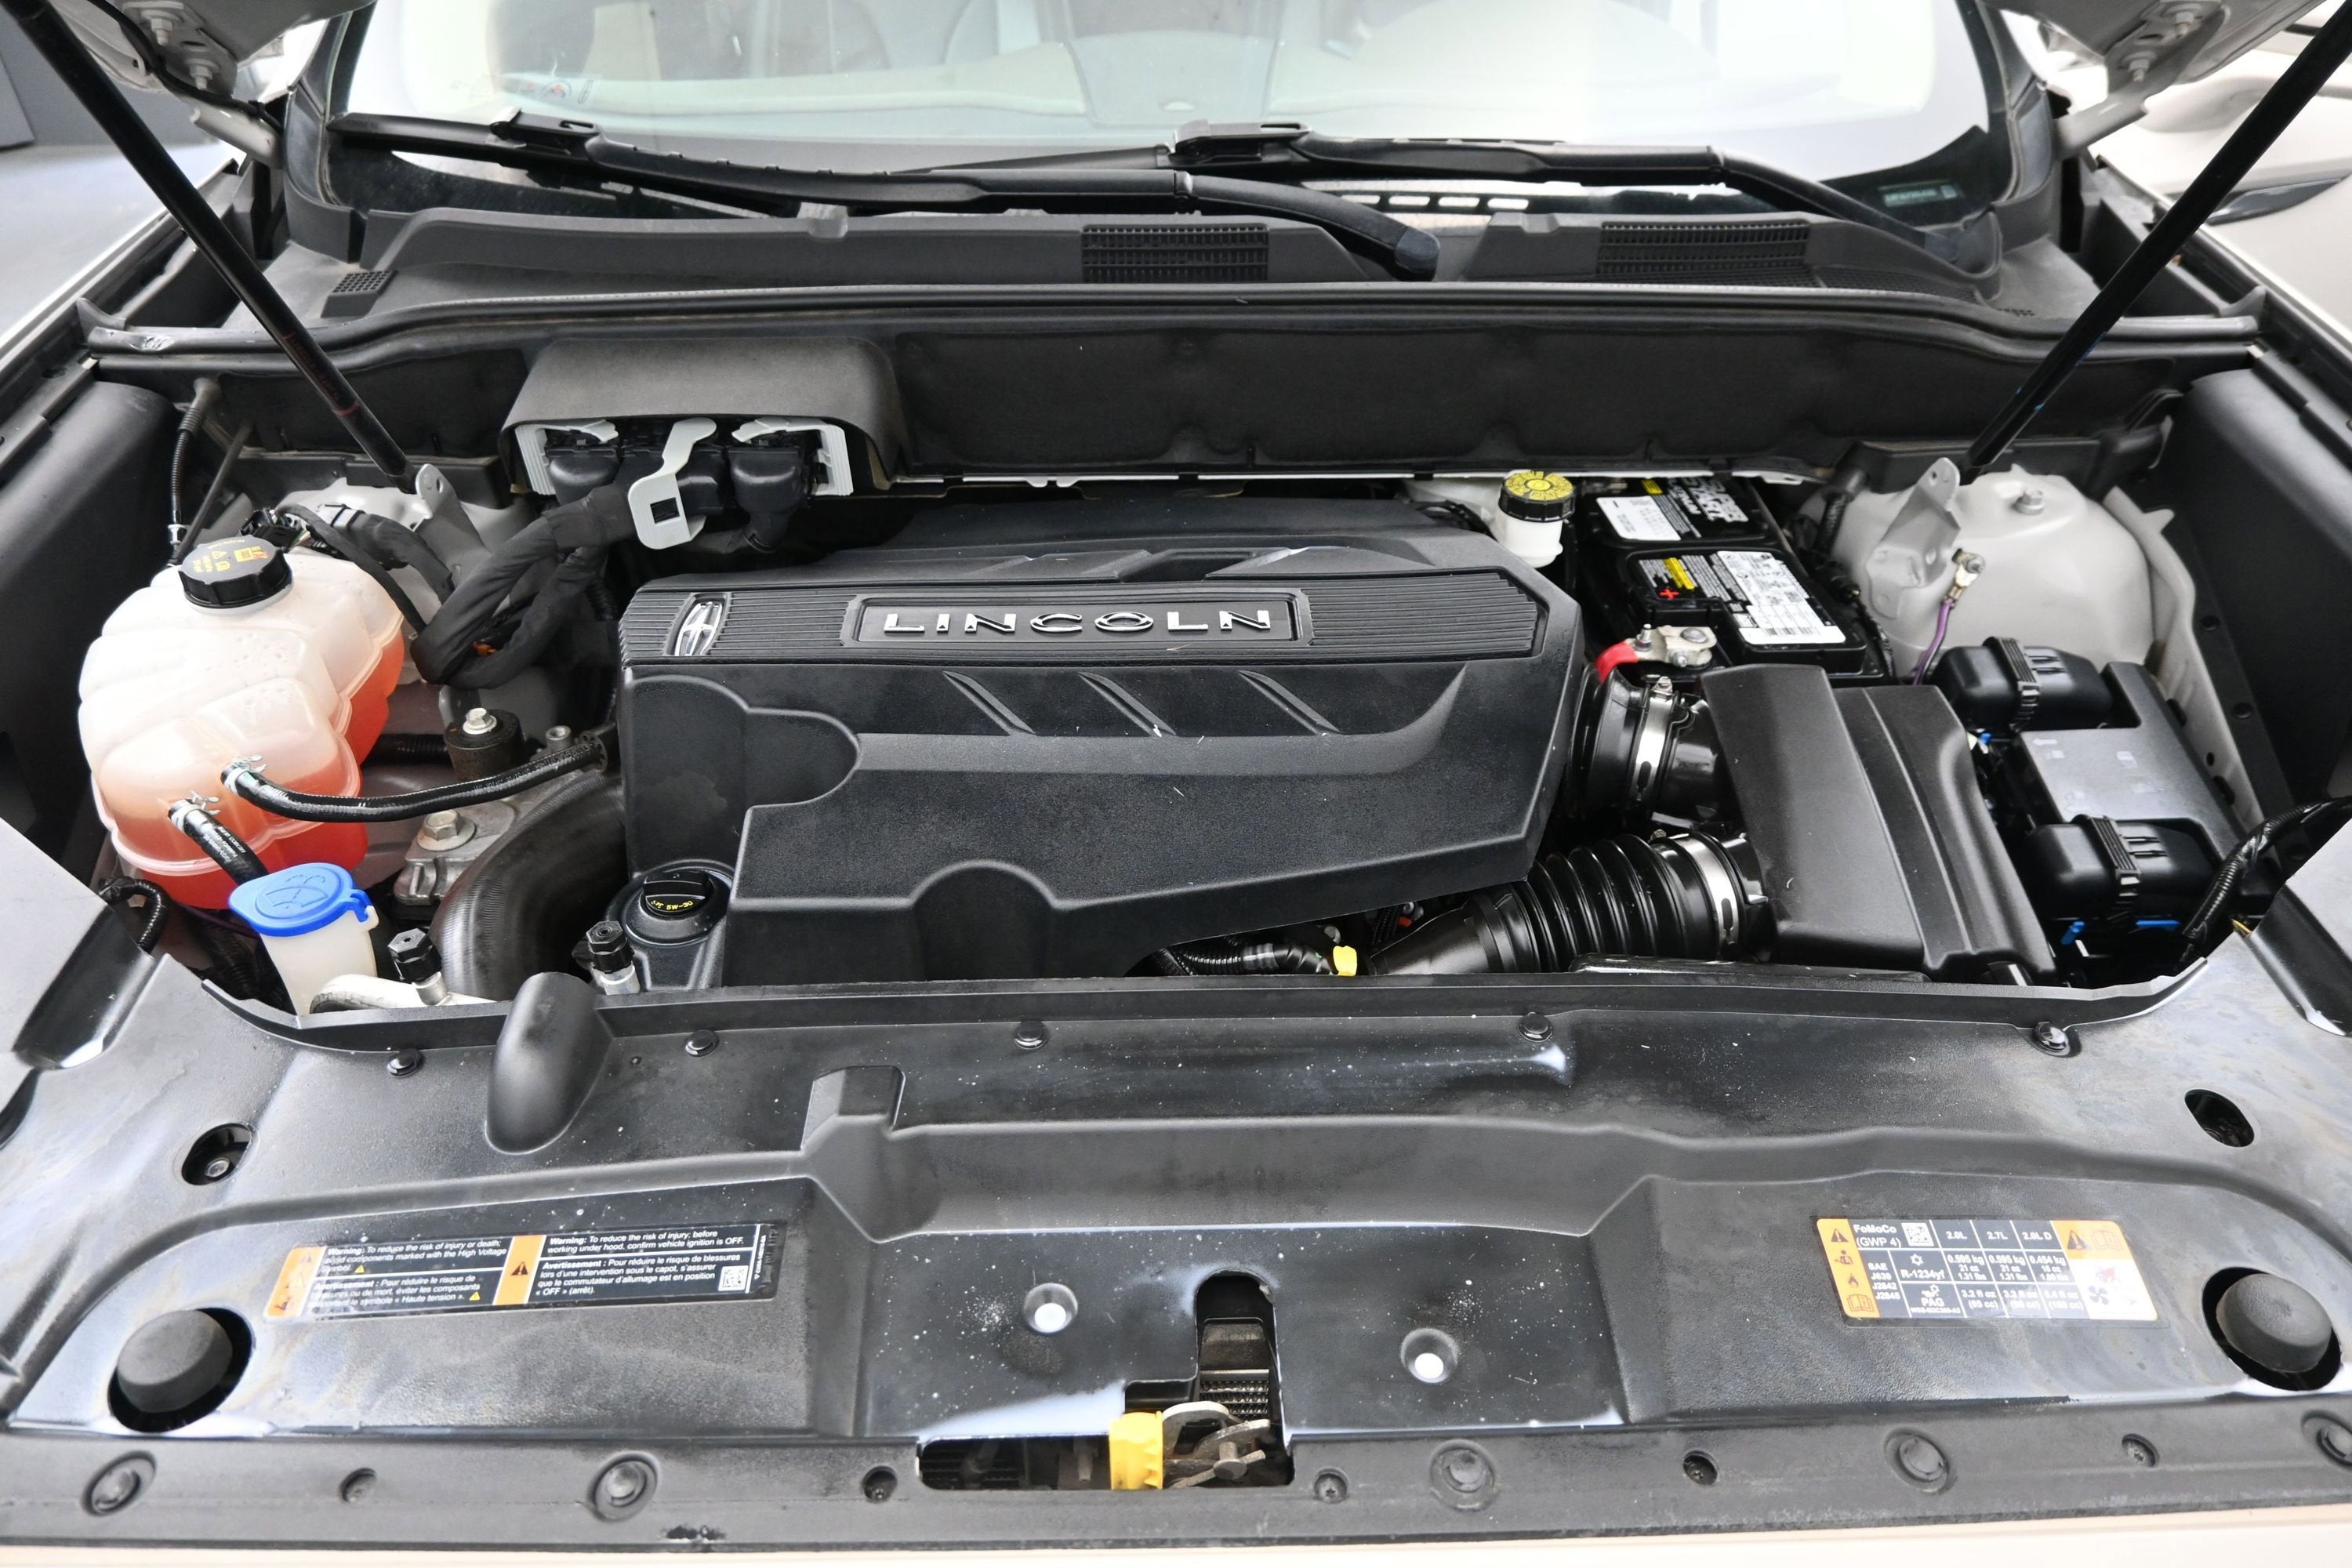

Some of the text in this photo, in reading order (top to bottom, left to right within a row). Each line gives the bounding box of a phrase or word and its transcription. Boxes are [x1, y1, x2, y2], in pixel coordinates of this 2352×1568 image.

[884, 610, 1271, 633] LINCOLN
[666, 900, 694, 910] 5W-30
[1853, 1224, 1897, 1233] FoMoCo
[2022, 1232, 2042, 1240] 2.0L
[687, 1239, 715, 1248] ignition
[725, 1236, 744, 1245] OFF.
[1857, 1238, 1901, 1248] (GWP 4)
[377, 1245, 405, 1254] reduce
[444, 1241, 466, 1250] injury
[347, 1254, 394, 1264] components
[395, 1252, 426, 1261] marked
[457, 1248, 476, 1258] High
[477, 1248, 507, 1257] Voltage
[1972, 1255, 1985, 1265] kg
[2013, 1255, 2026, 1266] kg
[2053, 1256, 2067, 1266] kg
[542, 1260, 602, 1269] Avertissement
[666, 1256, 690, 1265] risque
[579, 1268, 625, 1276] intervention
[1900, 1270, 1945, 1280] R-1234yf
[439, 1276, 464, 1284] risque
[563, 1277, 614, 1286] commutateur
[684, 1272, 716, 1281] position
[433, 1284, 481, 1293] composants
[360, 1297, 393, 1306] symbole
[401, 1294, 426, 1303] Haute
[1921, 1297, 1944, 1307] PAG
